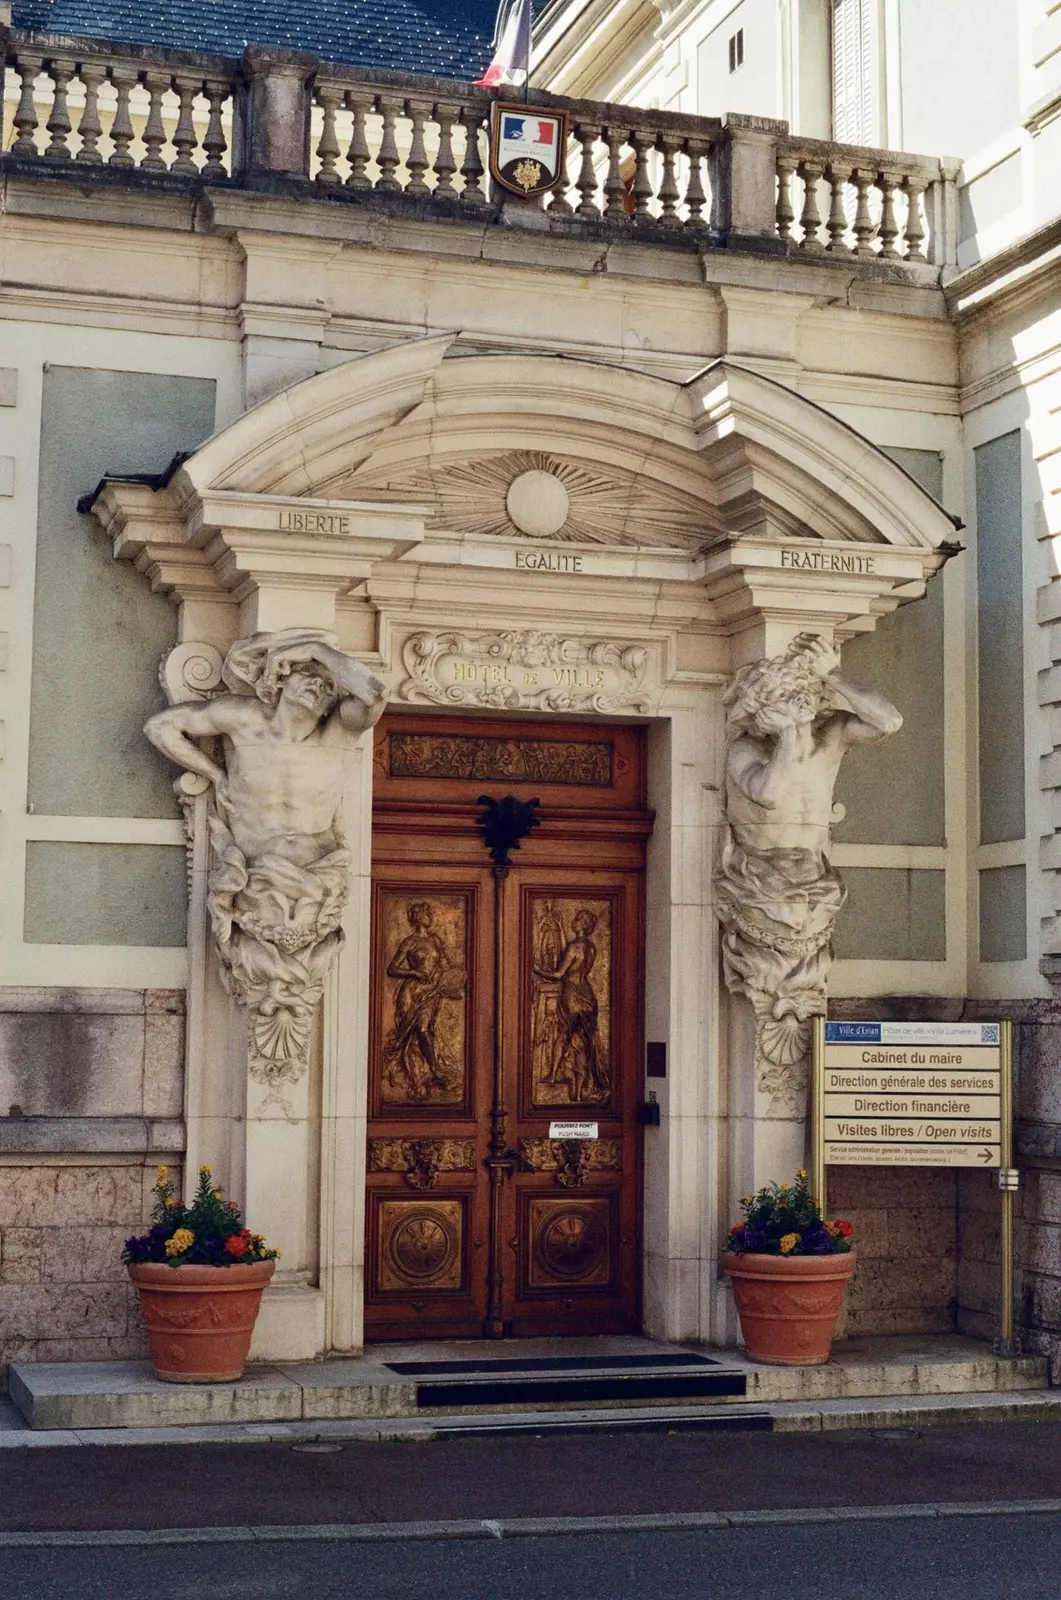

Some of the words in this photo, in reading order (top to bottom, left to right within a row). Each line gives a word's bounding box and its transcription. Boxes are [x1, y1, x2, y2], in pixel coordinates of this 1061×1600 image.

[278, 512, 349, 534] LIBERTE
[515, 551, 582, 572] EGALITE
[781, 550, 875, 574] FRATERNITE
[453, 661, 512, 683] HÔTEL
[553, 668, 604, 688] VILLE
[839, 1025, 854, 1035] Ville
[861, 1051, 907, 1064] Cabinet
[911, 1052, 926, 1064] du
[929, 1052, 963, 1064] maire
[830, 1075, 877, 1087] Direction
[880, 1075, 925, 1090] générale
[928, 1076, 947, 1088] des
[950, 1077, 994, 1089] services
[854, 1099, 908, 1112] Direction
[911, 1100, 971, 1113] financière
[837, 1124, 877, 1136] Visites
[881, 1124, 914, 1137] libres
[925, 1125, 957, 1140] Open
[960, 1126, 992, 1138] visits
